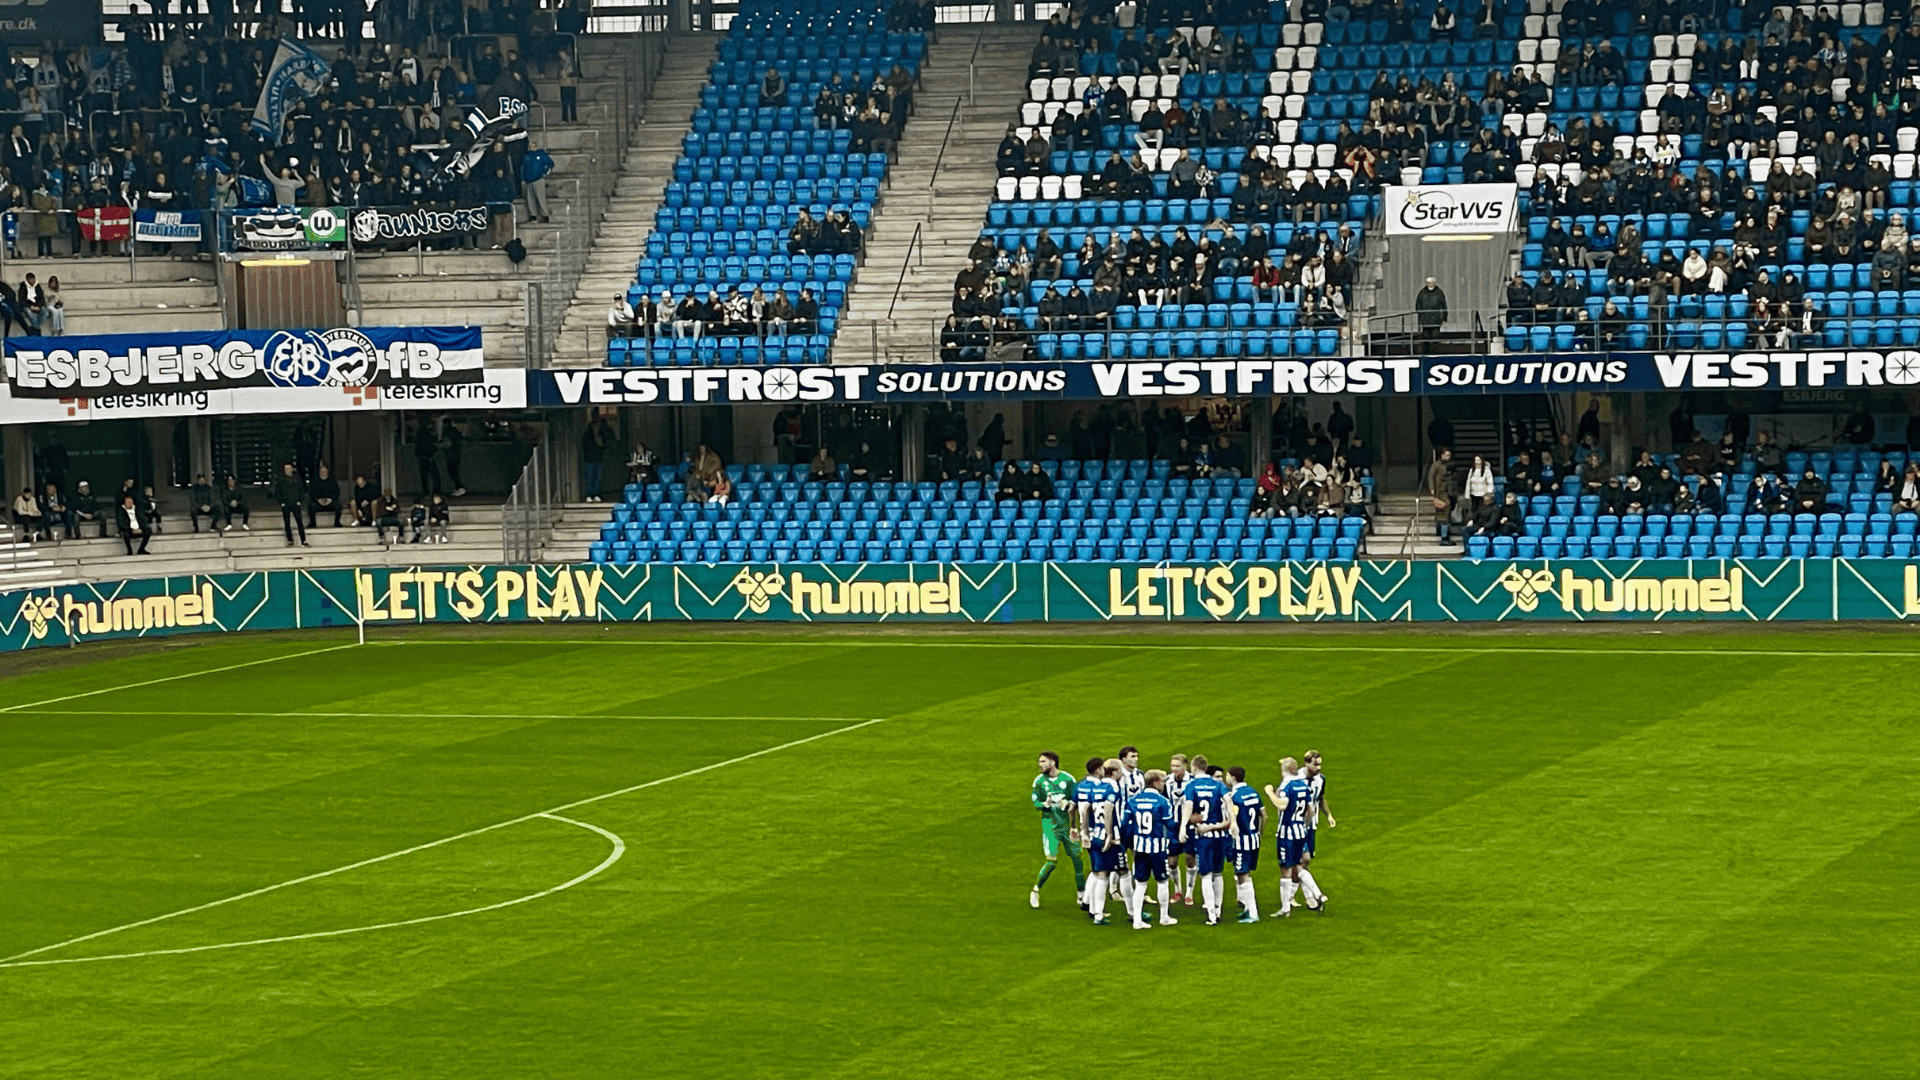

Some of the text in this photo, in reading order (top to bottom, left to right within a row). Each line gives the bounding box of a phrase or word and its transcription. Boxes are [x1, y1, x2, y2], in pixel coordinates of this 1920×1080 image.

[377, 206, 487, 238] JUNIORS
[15, 340, 443, 388] ESBJERG fB
[553, 368, 1066, 403] VESTFROST SOLUTIONS
[1092, 360, 1627, 396] VESTFROST SOLUTIONS
[1783, 391, 1844, 402] ESBJERG
[64, 583, 214, 633] hummel
[360, 570, 604, 620] LET'S PLAY
[792, 571, 960, 614] hummel
[1109, 567, 1361, 616] LET'S PLAY
[1562, 568, 1743, 612] hummel
[1135, 811, 1153, 835] 19
